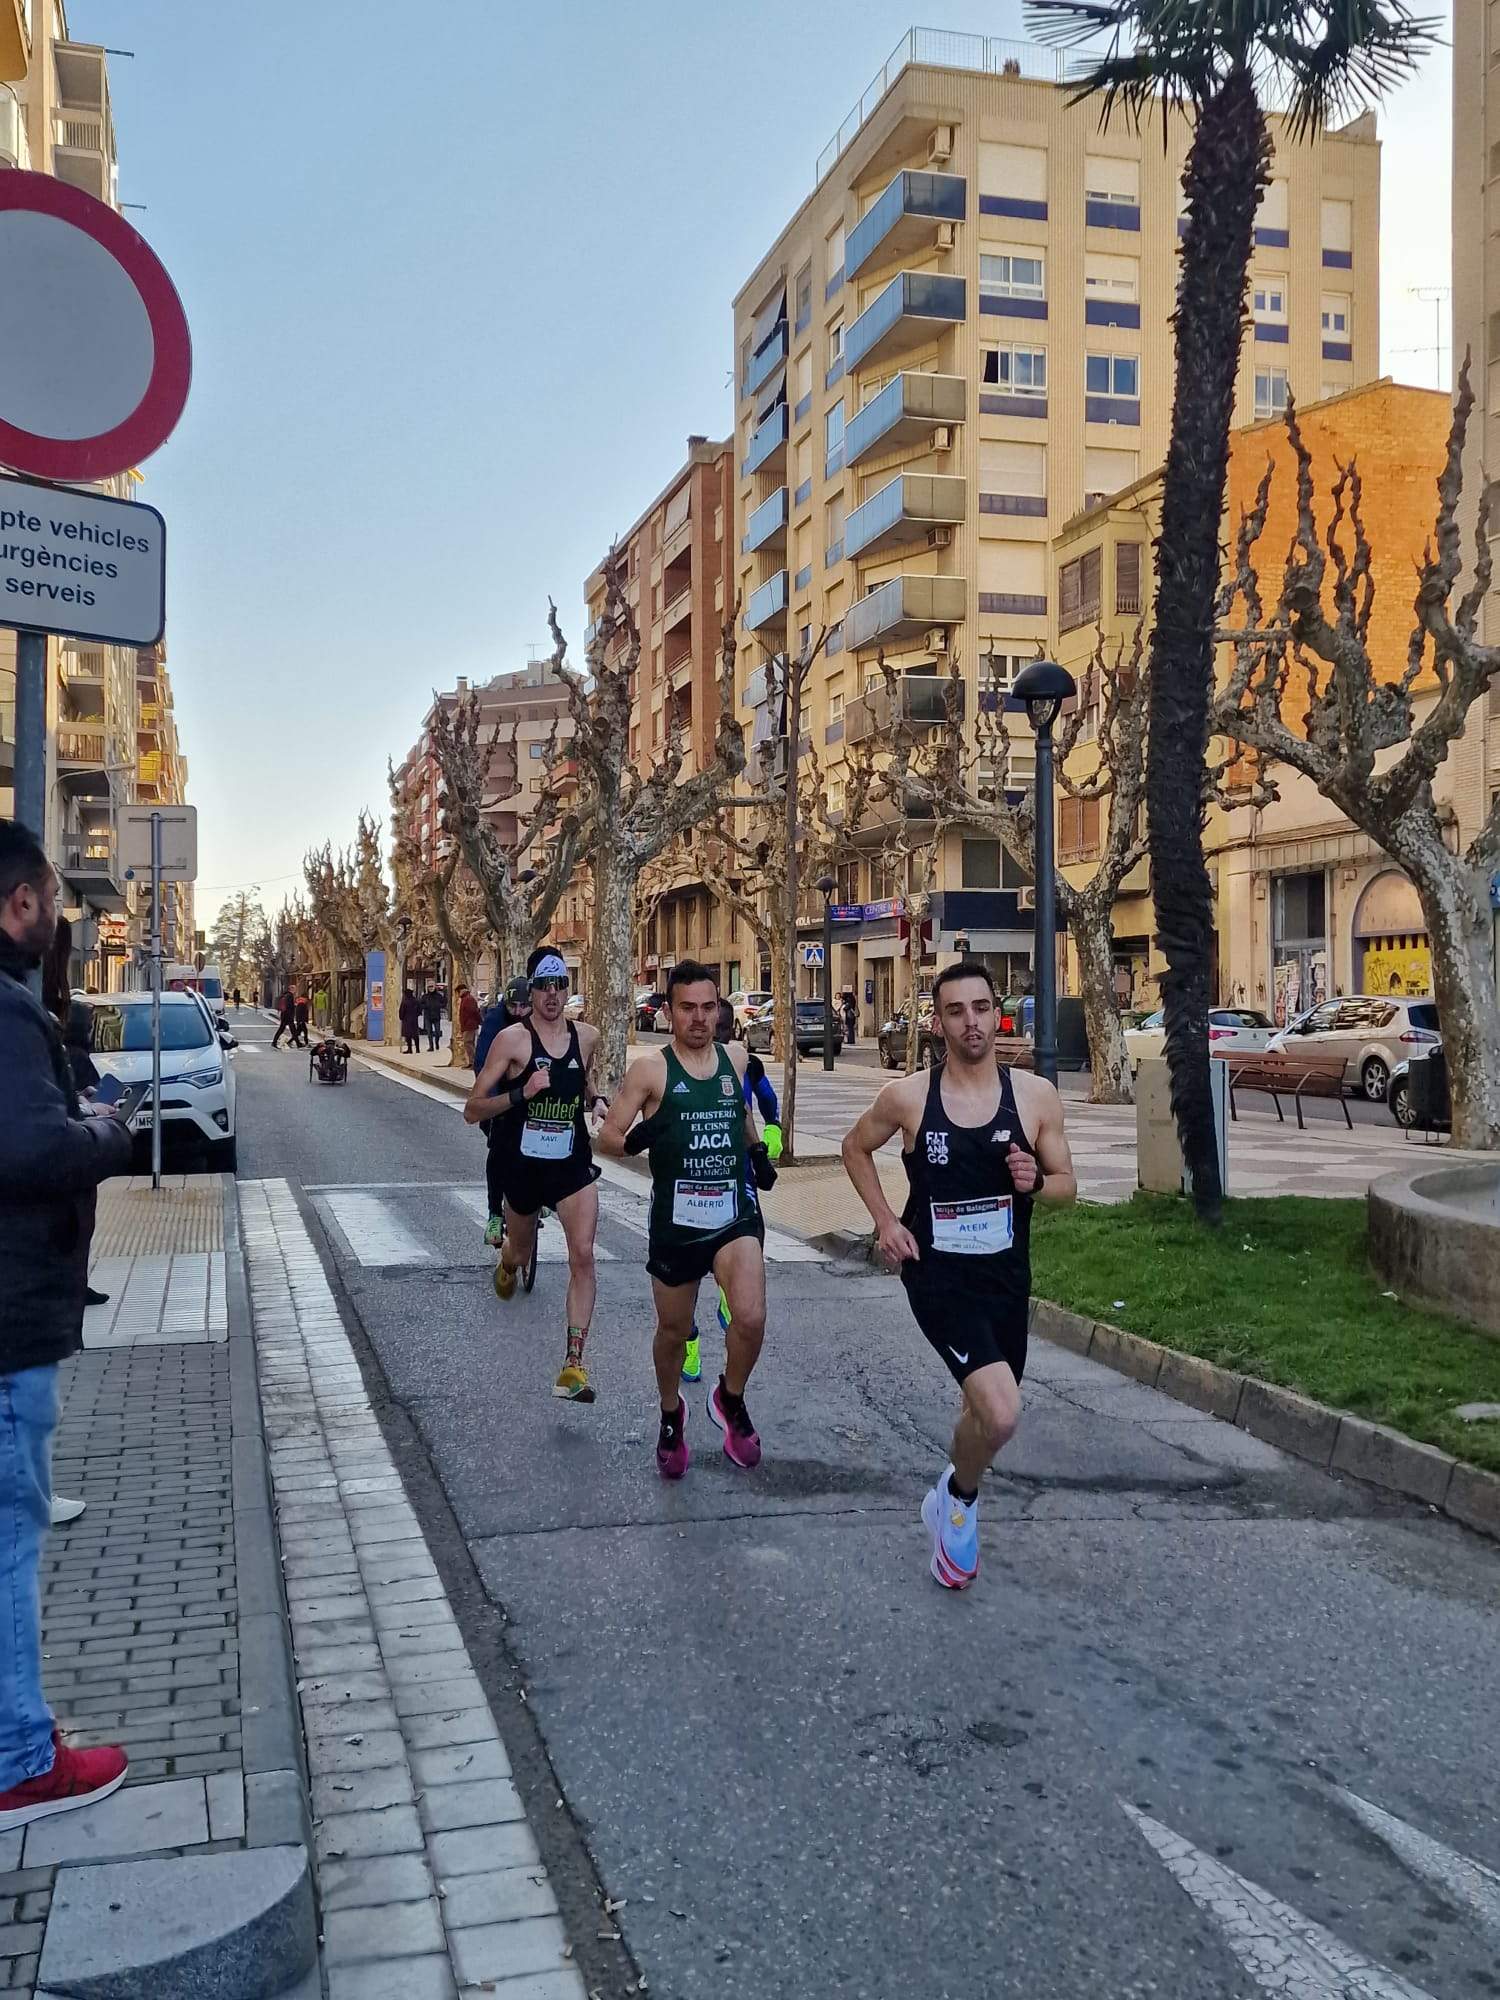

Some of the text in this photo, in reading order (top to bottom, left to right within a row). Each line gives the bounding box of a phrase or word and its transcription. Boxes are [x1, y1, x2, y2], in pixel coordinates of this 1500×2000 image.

[1, 511, 149, 553] pte vehicles
[5, 576, 96, 606] serveis
[865, 901, 887, 915] CENTRE
[680, 1109, 737, 1120] FLORISTERÍA
[690, 1122, 730, 1132] EL CISNE
[689, 1133, 732, 1150] JACA
[927, 1145, 949, 1154] AND
[927, 1153, 949, 1165] GO
[687, 1200, 724, 1208] ALBERTO
